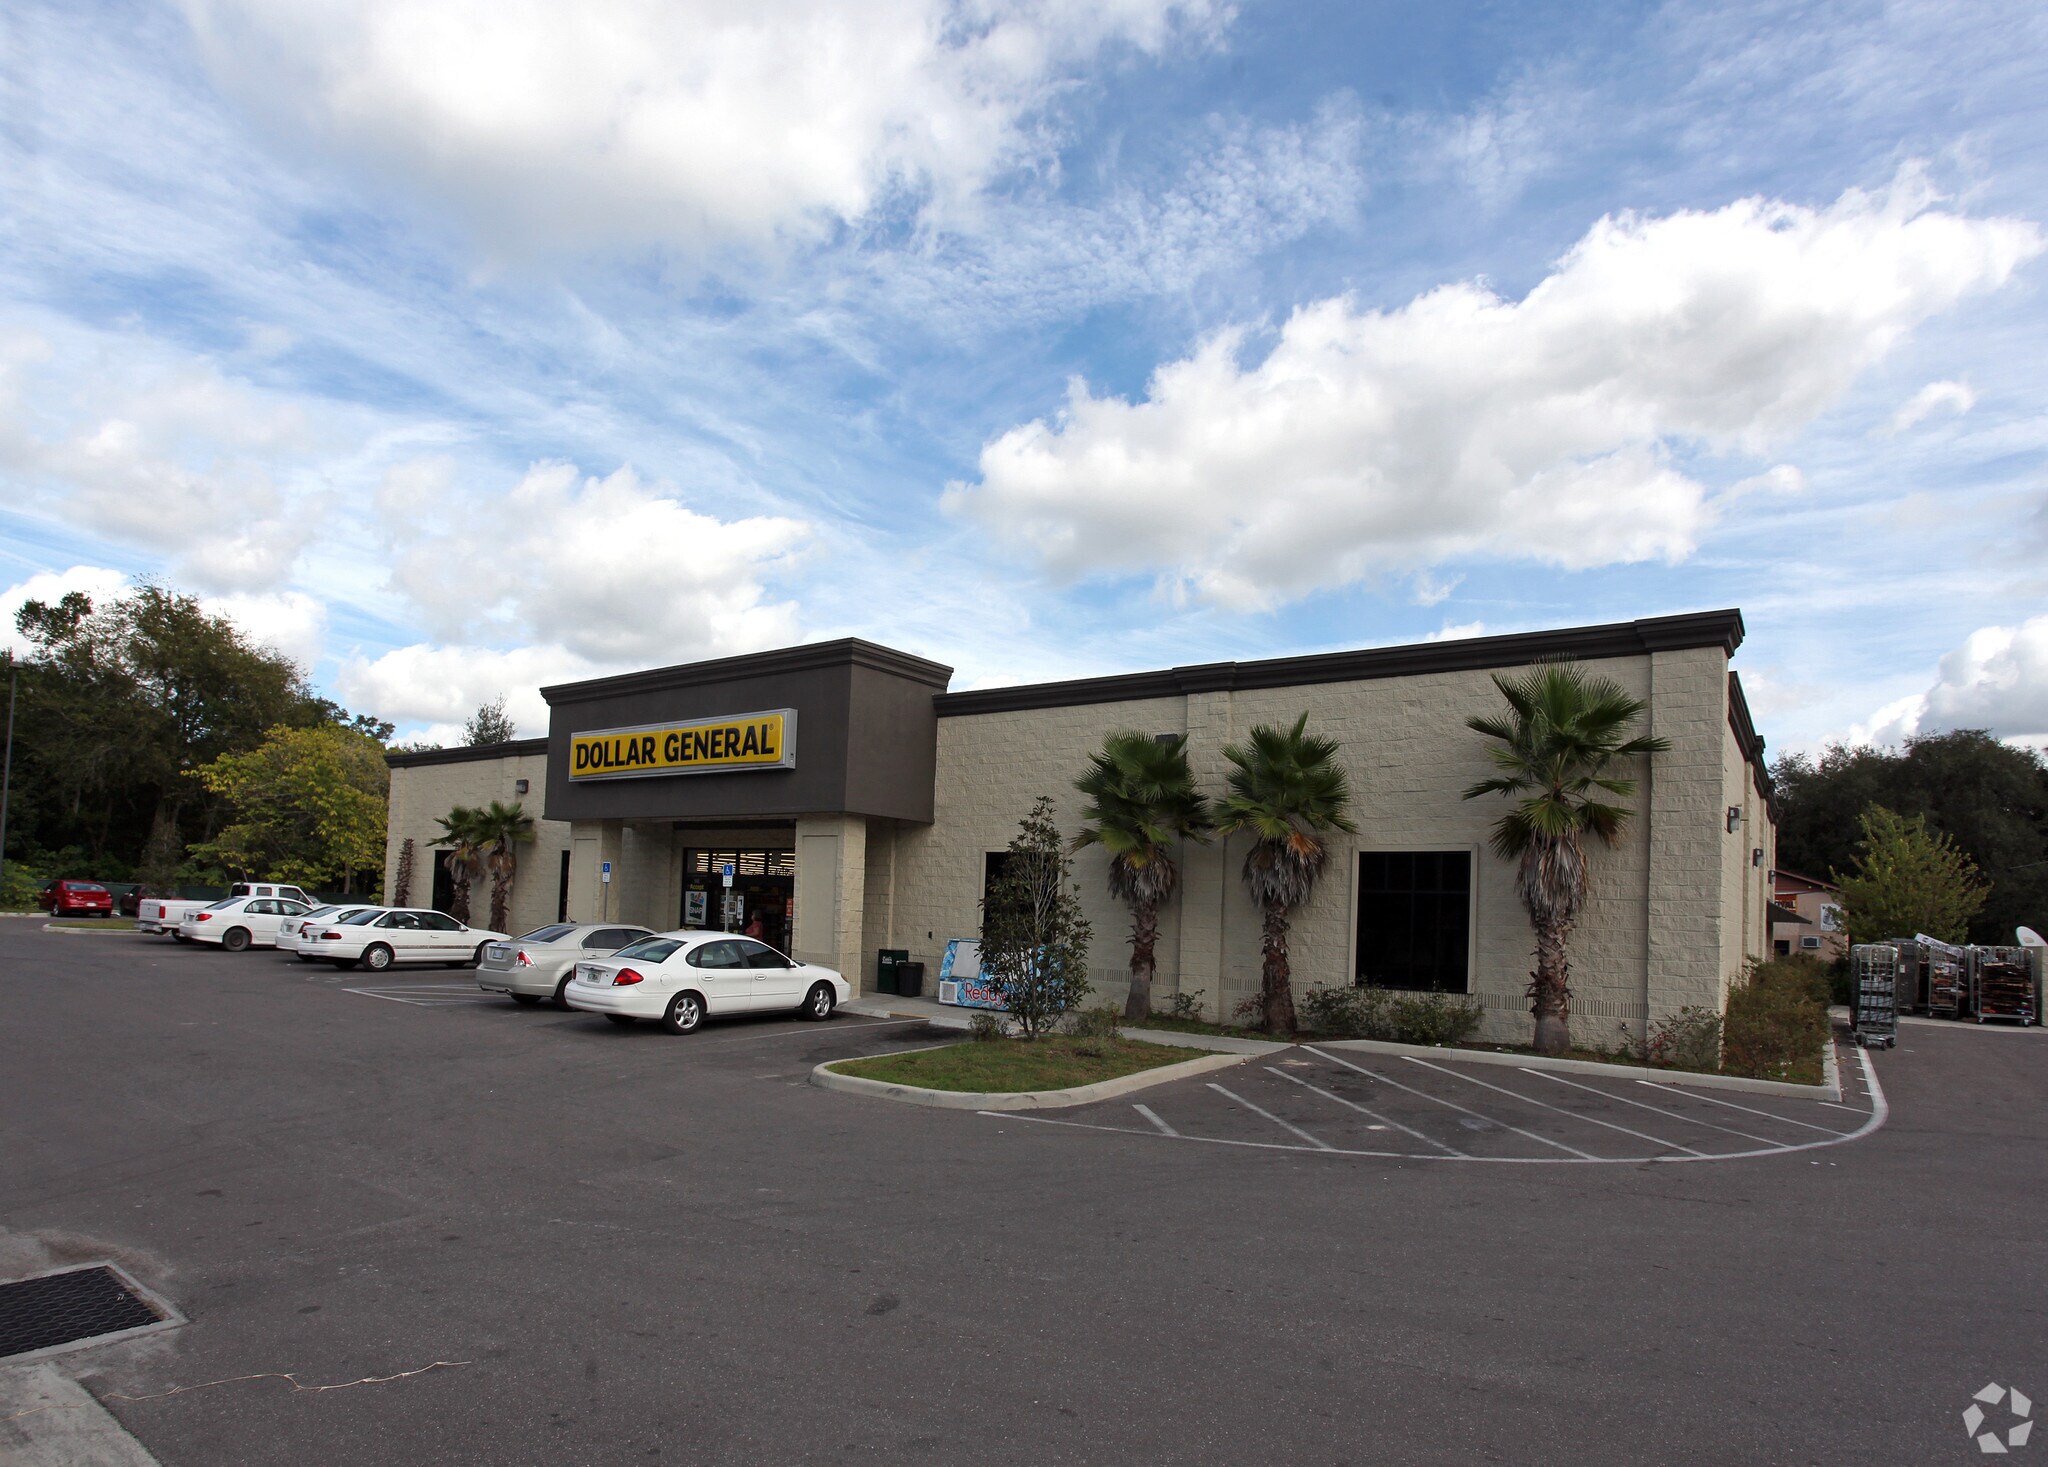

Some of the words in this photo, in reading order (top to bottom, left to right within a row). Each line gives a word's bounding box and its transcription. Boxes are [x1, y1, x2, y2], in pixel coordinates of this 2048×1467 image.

[576, 736, 656, 769] DOLLAR
[664, 724, 774, 763] GENERAL
[689, 906, 703, 915] SNAP
